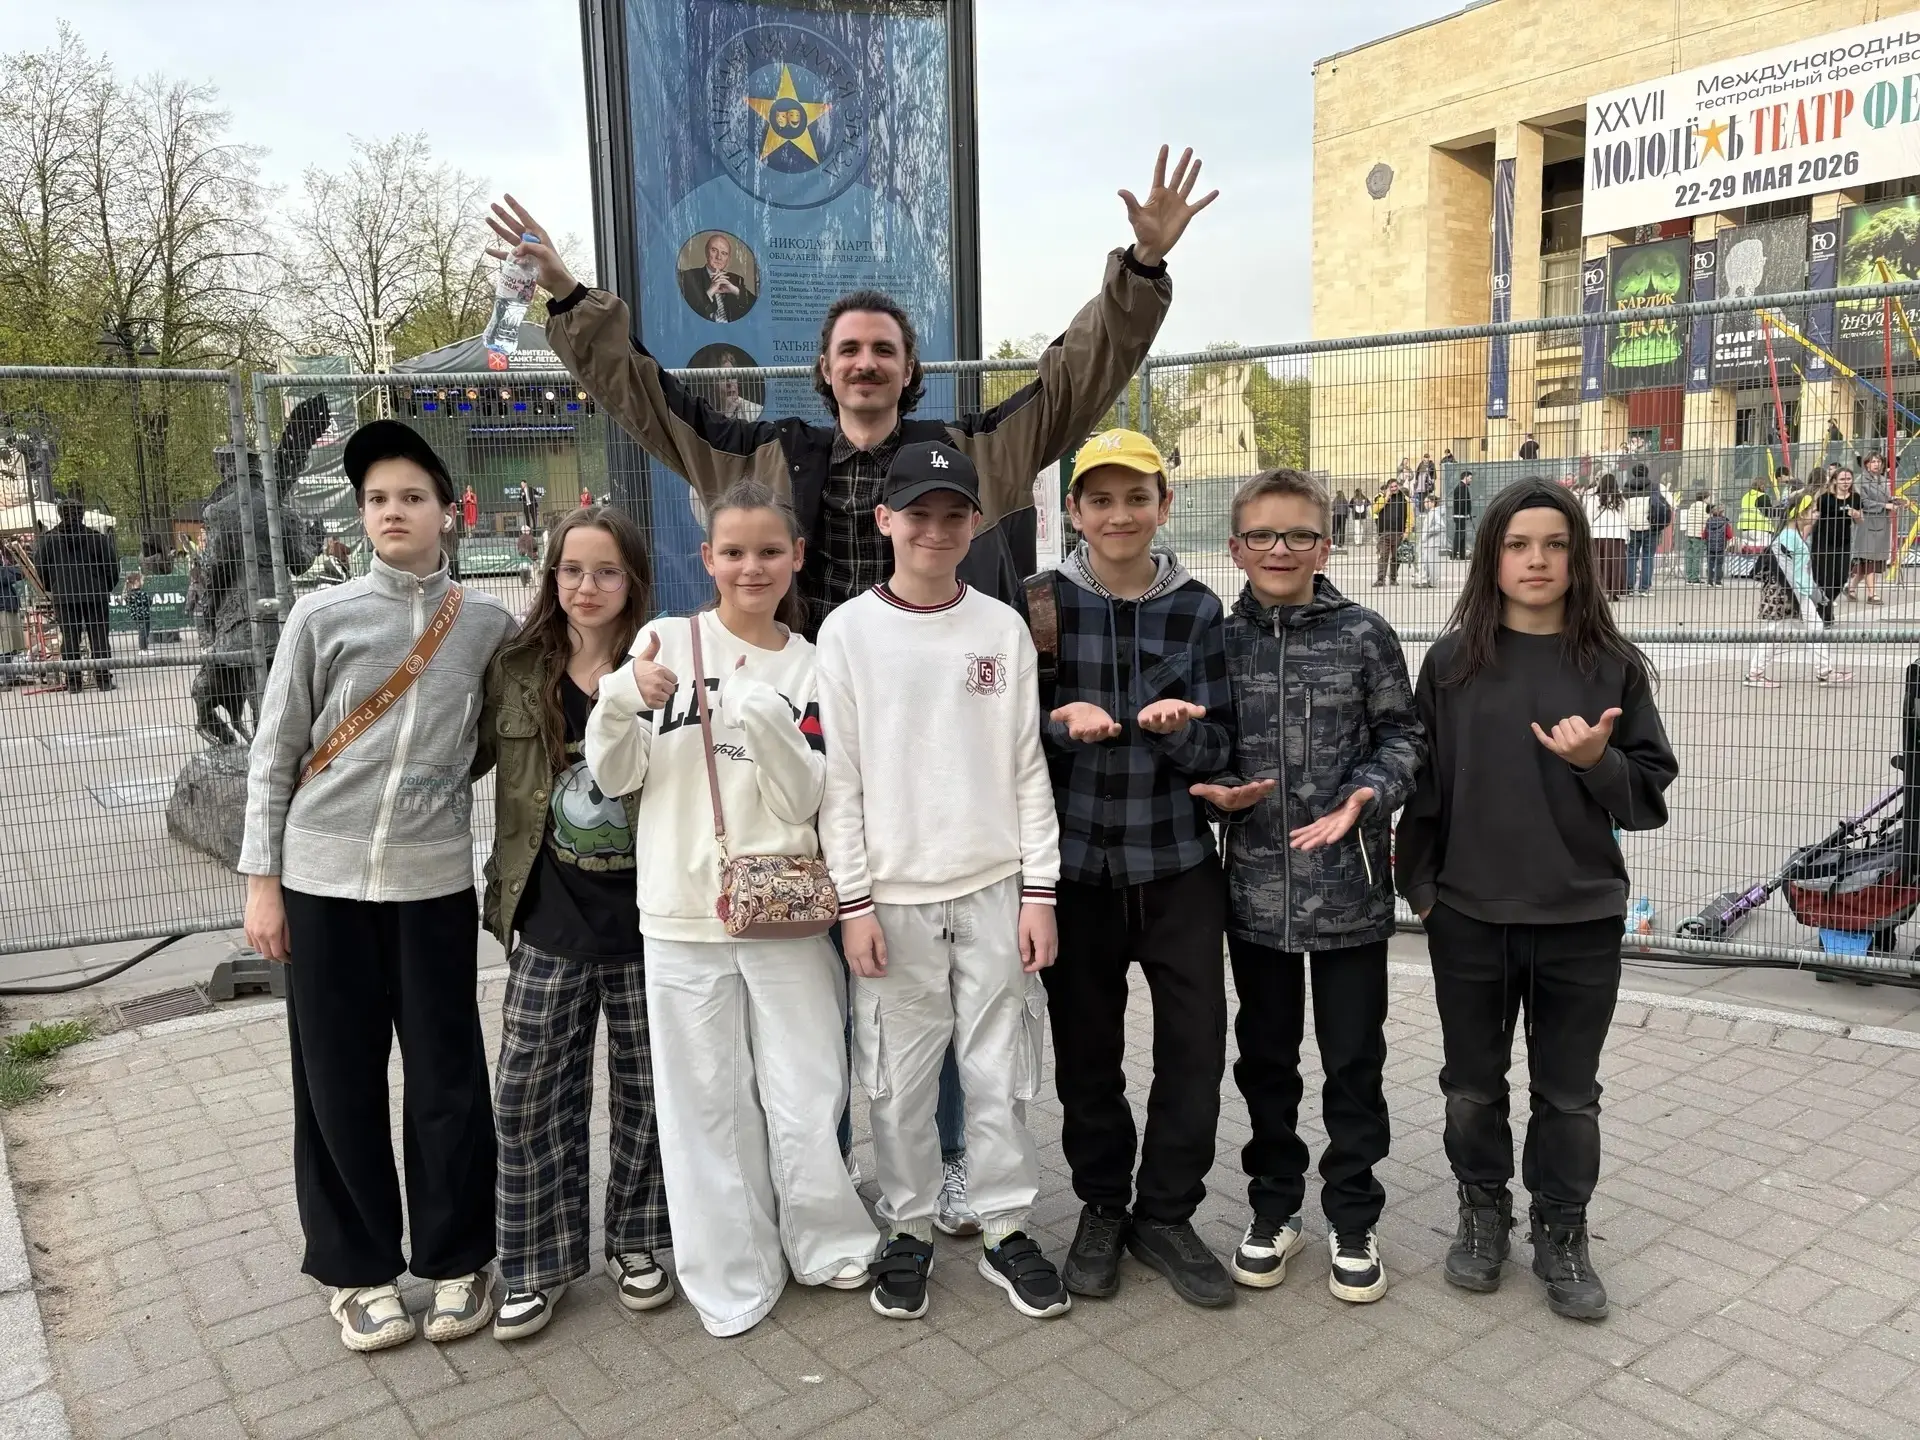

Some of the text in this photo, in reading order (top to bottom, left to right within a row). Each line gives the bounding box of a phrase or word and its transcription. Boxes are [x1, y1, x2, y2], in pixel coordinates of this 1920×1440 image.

[1696, 69, 1822, 111] театральный
[1594, 89, 1665, 136] XXVII
[1750, 88, 1854, 155] ТЕАТР
[1674, 151, 1859, 208] 22-29 МАЯ 2026
[769, 236, 831, 250] НИКОЛАЙ
[854, 255, 872, 263] 2022
[873, 255, 896, 264] ГДА
[1616, 293, 1677, 312] КАРЛИК
[508, 355, 563, 363] САНКТ-ПЕТЕР
[773, 354, 815, 364] ОБЛАДАТ
[1715, 346, 1753, 361] СЫН
[930, 450, 949, 469] LA
[981, 663, 992, 682] FS
